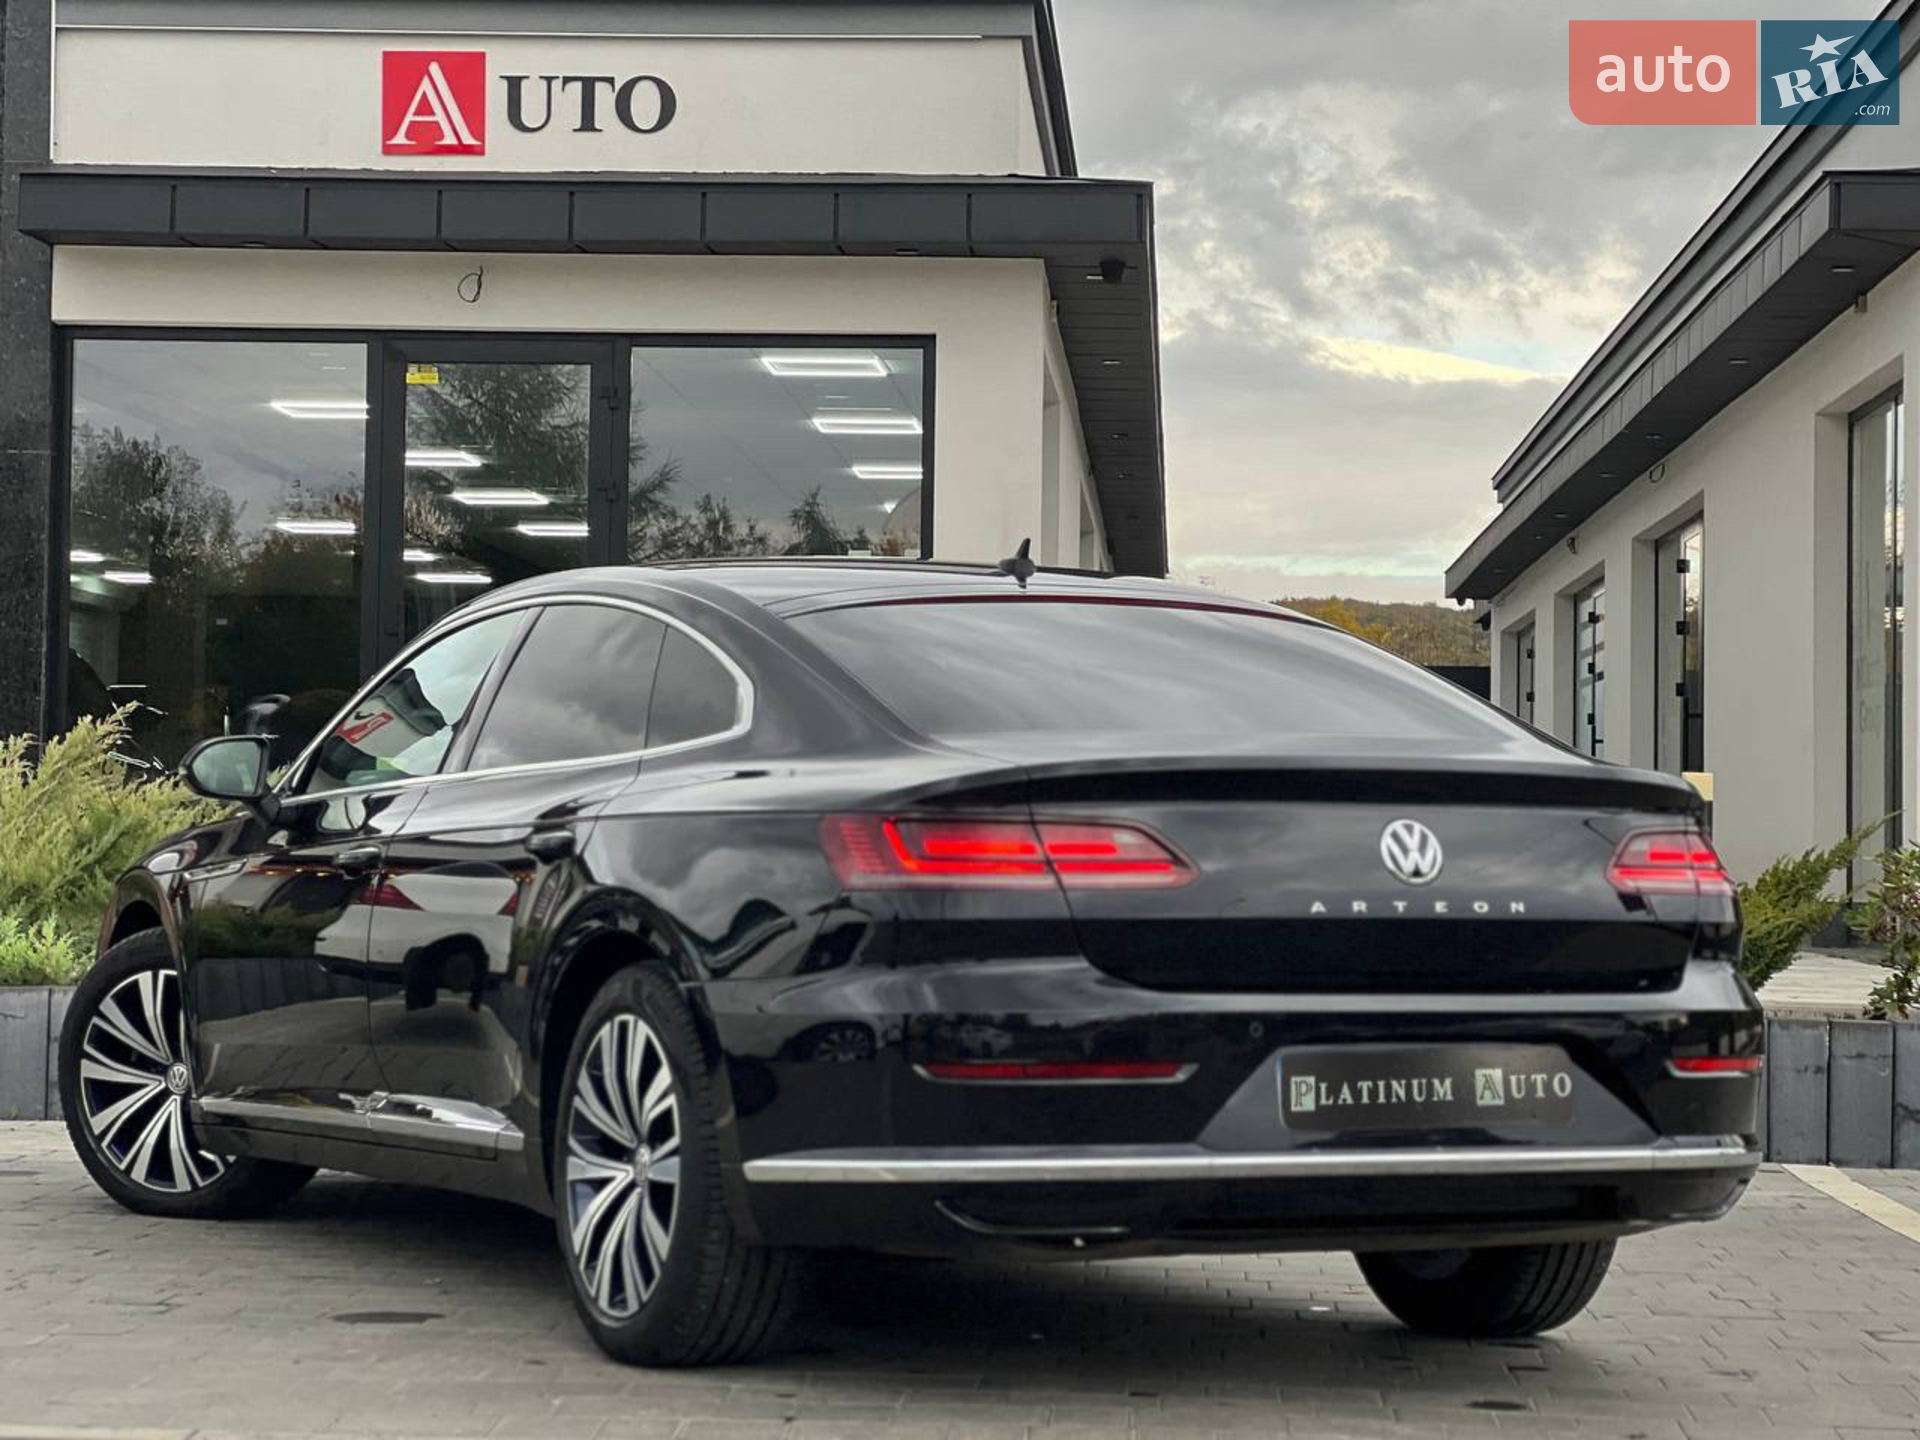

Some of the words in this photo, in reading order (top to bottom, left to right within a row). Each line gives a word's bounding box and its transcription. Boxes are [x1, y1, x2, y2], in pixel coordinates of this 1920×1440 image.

[385, 60, 677, 146] AUTO
[1380, 818, 1443, 884] VW
[1310, 900, 1526, 914] ARTEON
[1291, 1076, 1454, 1112] PLATINUM
[1475, 1068, 1573, 1106] AUTO
